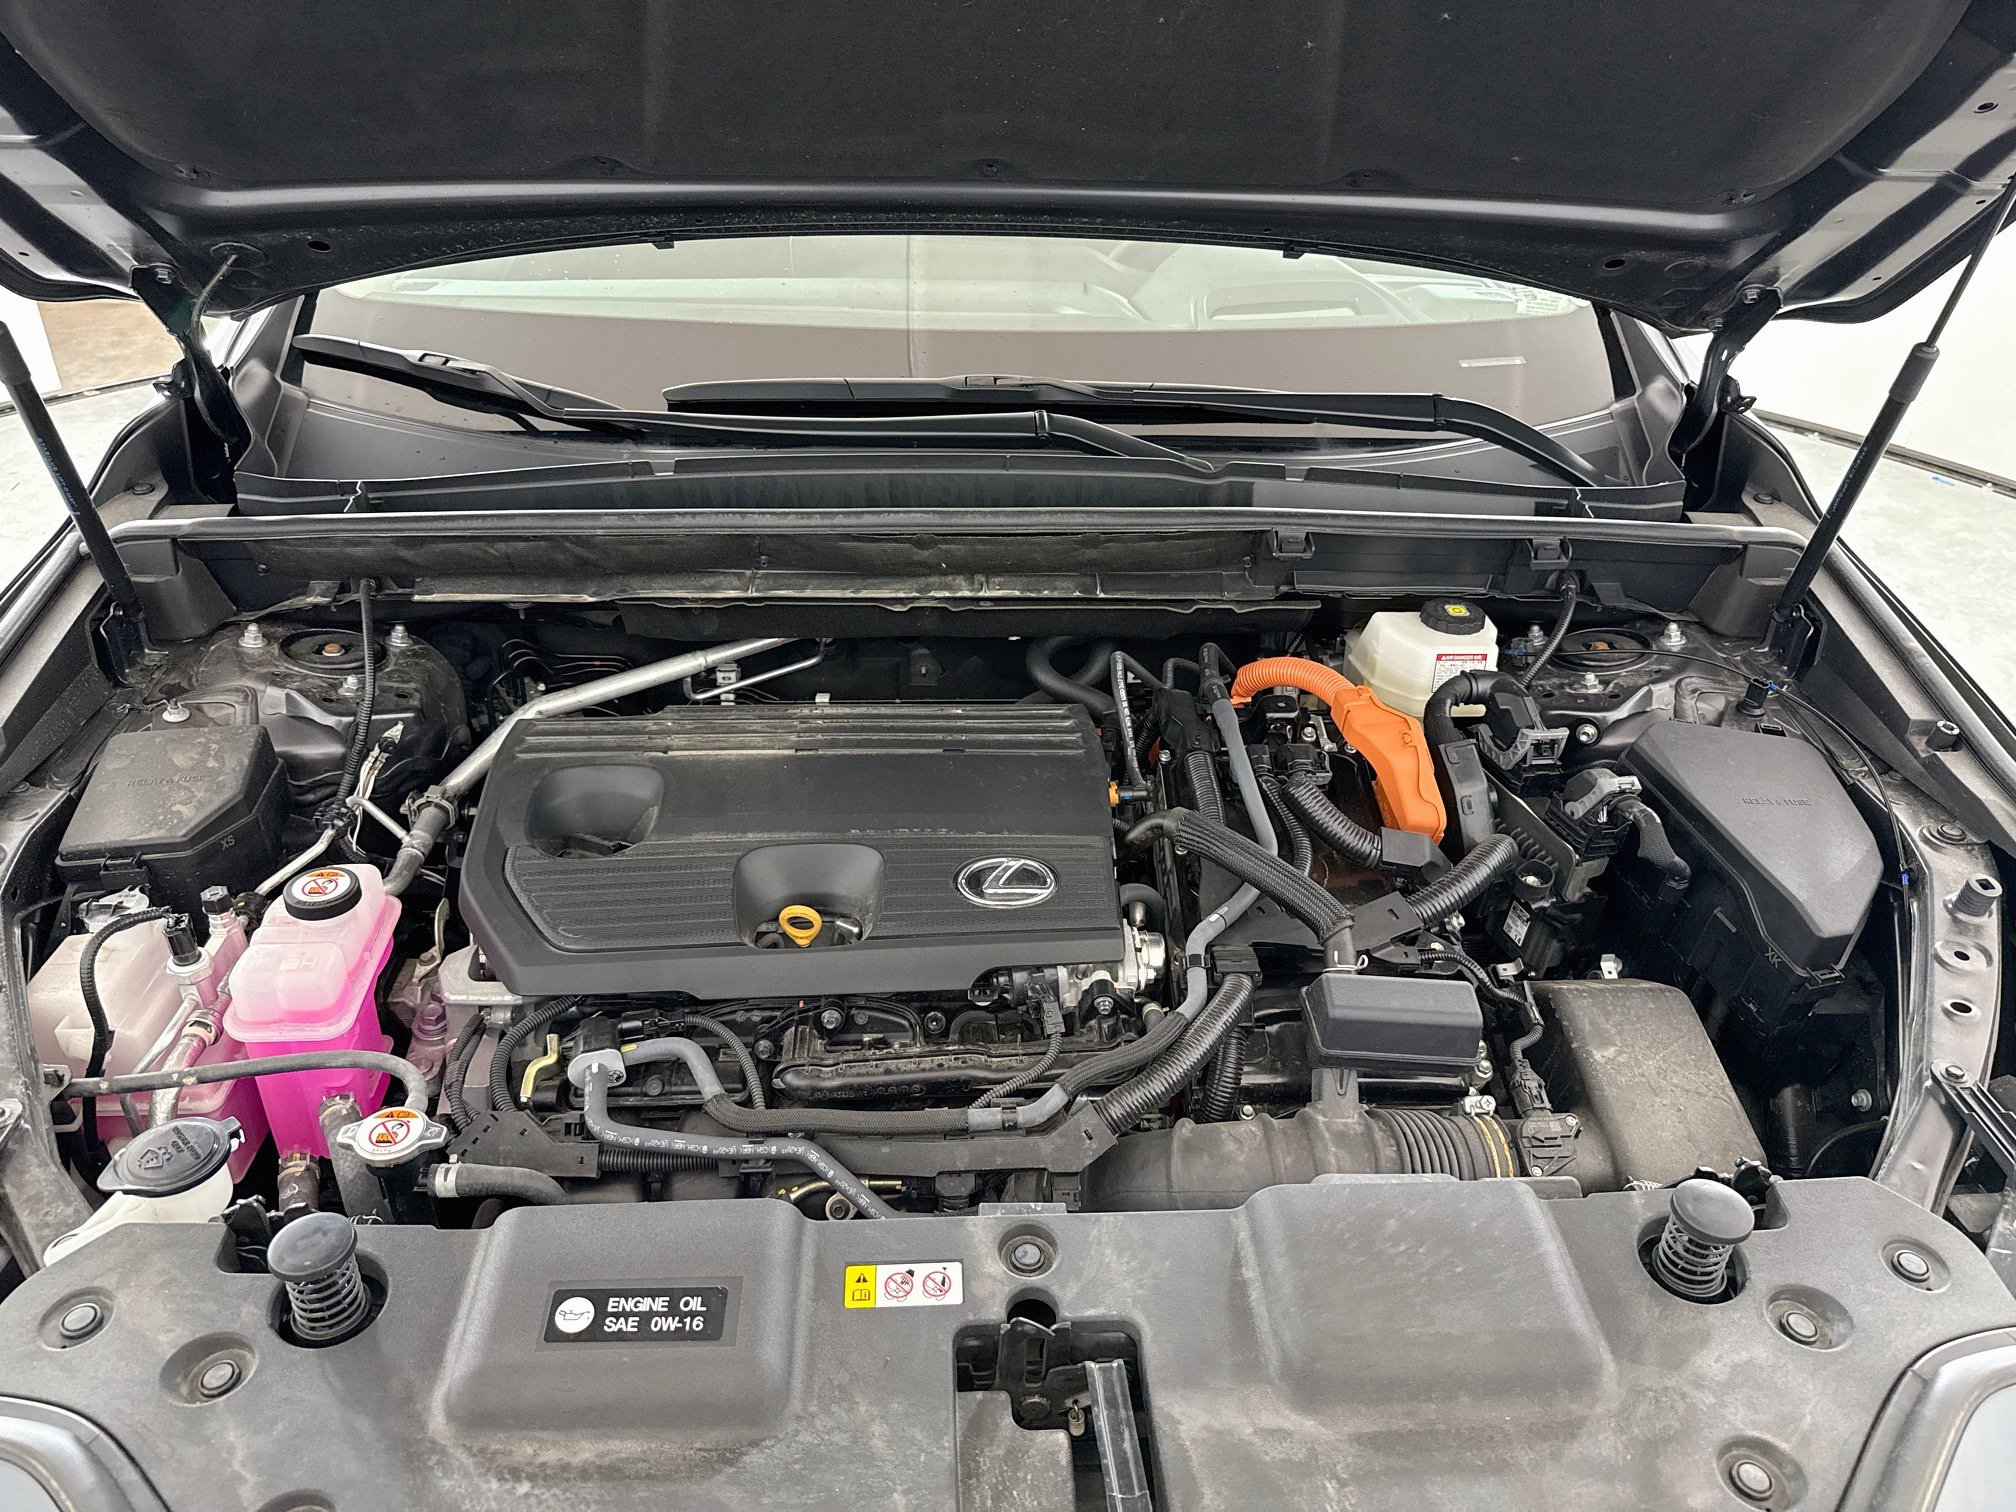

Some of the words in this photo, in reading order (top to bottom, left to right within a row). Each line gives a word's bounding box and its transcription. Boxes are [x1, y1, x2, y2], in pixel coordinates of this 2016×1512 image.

[607, 1296, 670, 1312] ENGINE
[679, 1296, 707, 1311] OIL
[603, 1316, 640, 1332] SAE
[650, 1316, 704, 1332] 0W-16
